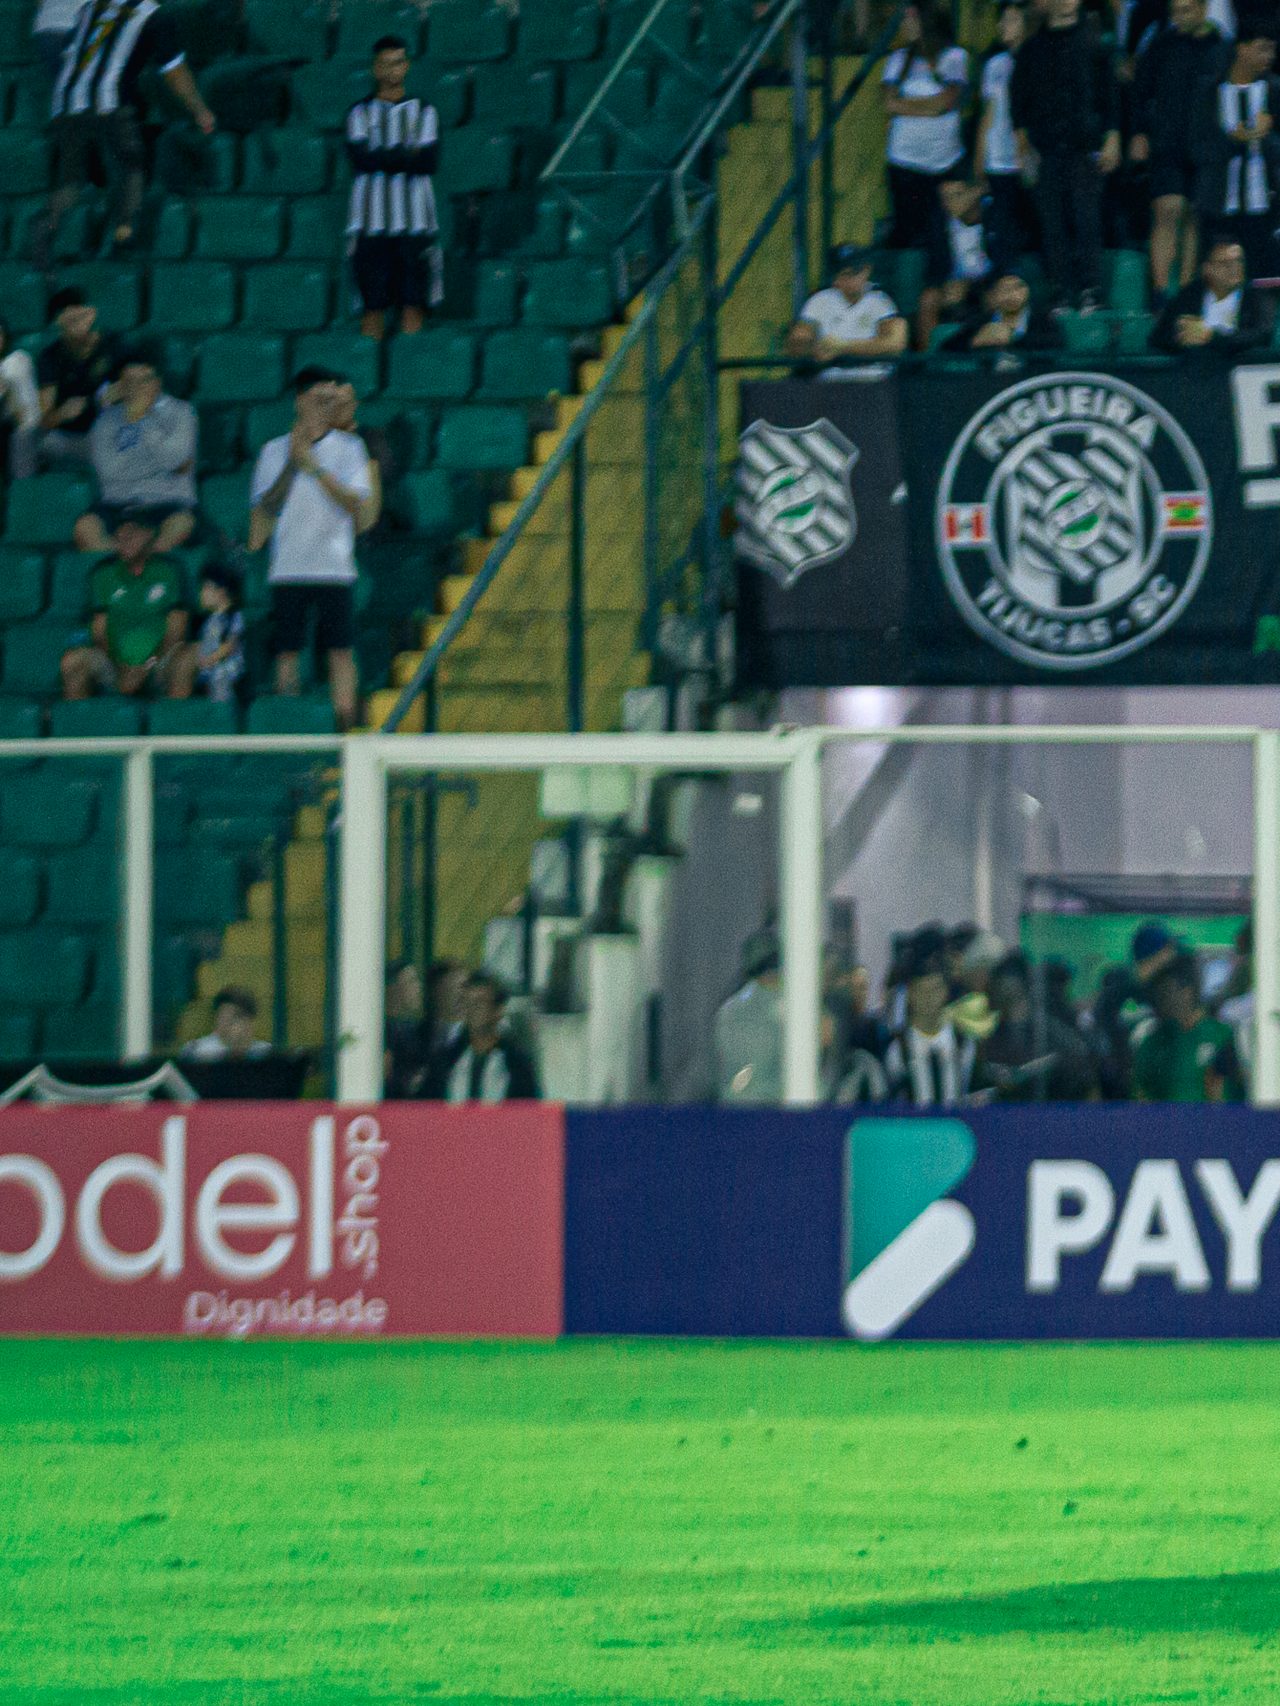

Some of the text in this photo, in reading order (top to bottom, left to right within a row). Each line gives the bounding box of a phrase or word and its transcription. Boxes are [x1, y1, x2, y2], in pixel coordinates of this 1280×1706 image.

[974, 385, 1159, 462] FIGUEIRA
[976, 576, 1112, 649] TIJUCAS
[184, 1290, 389, 1342] Dignidade
